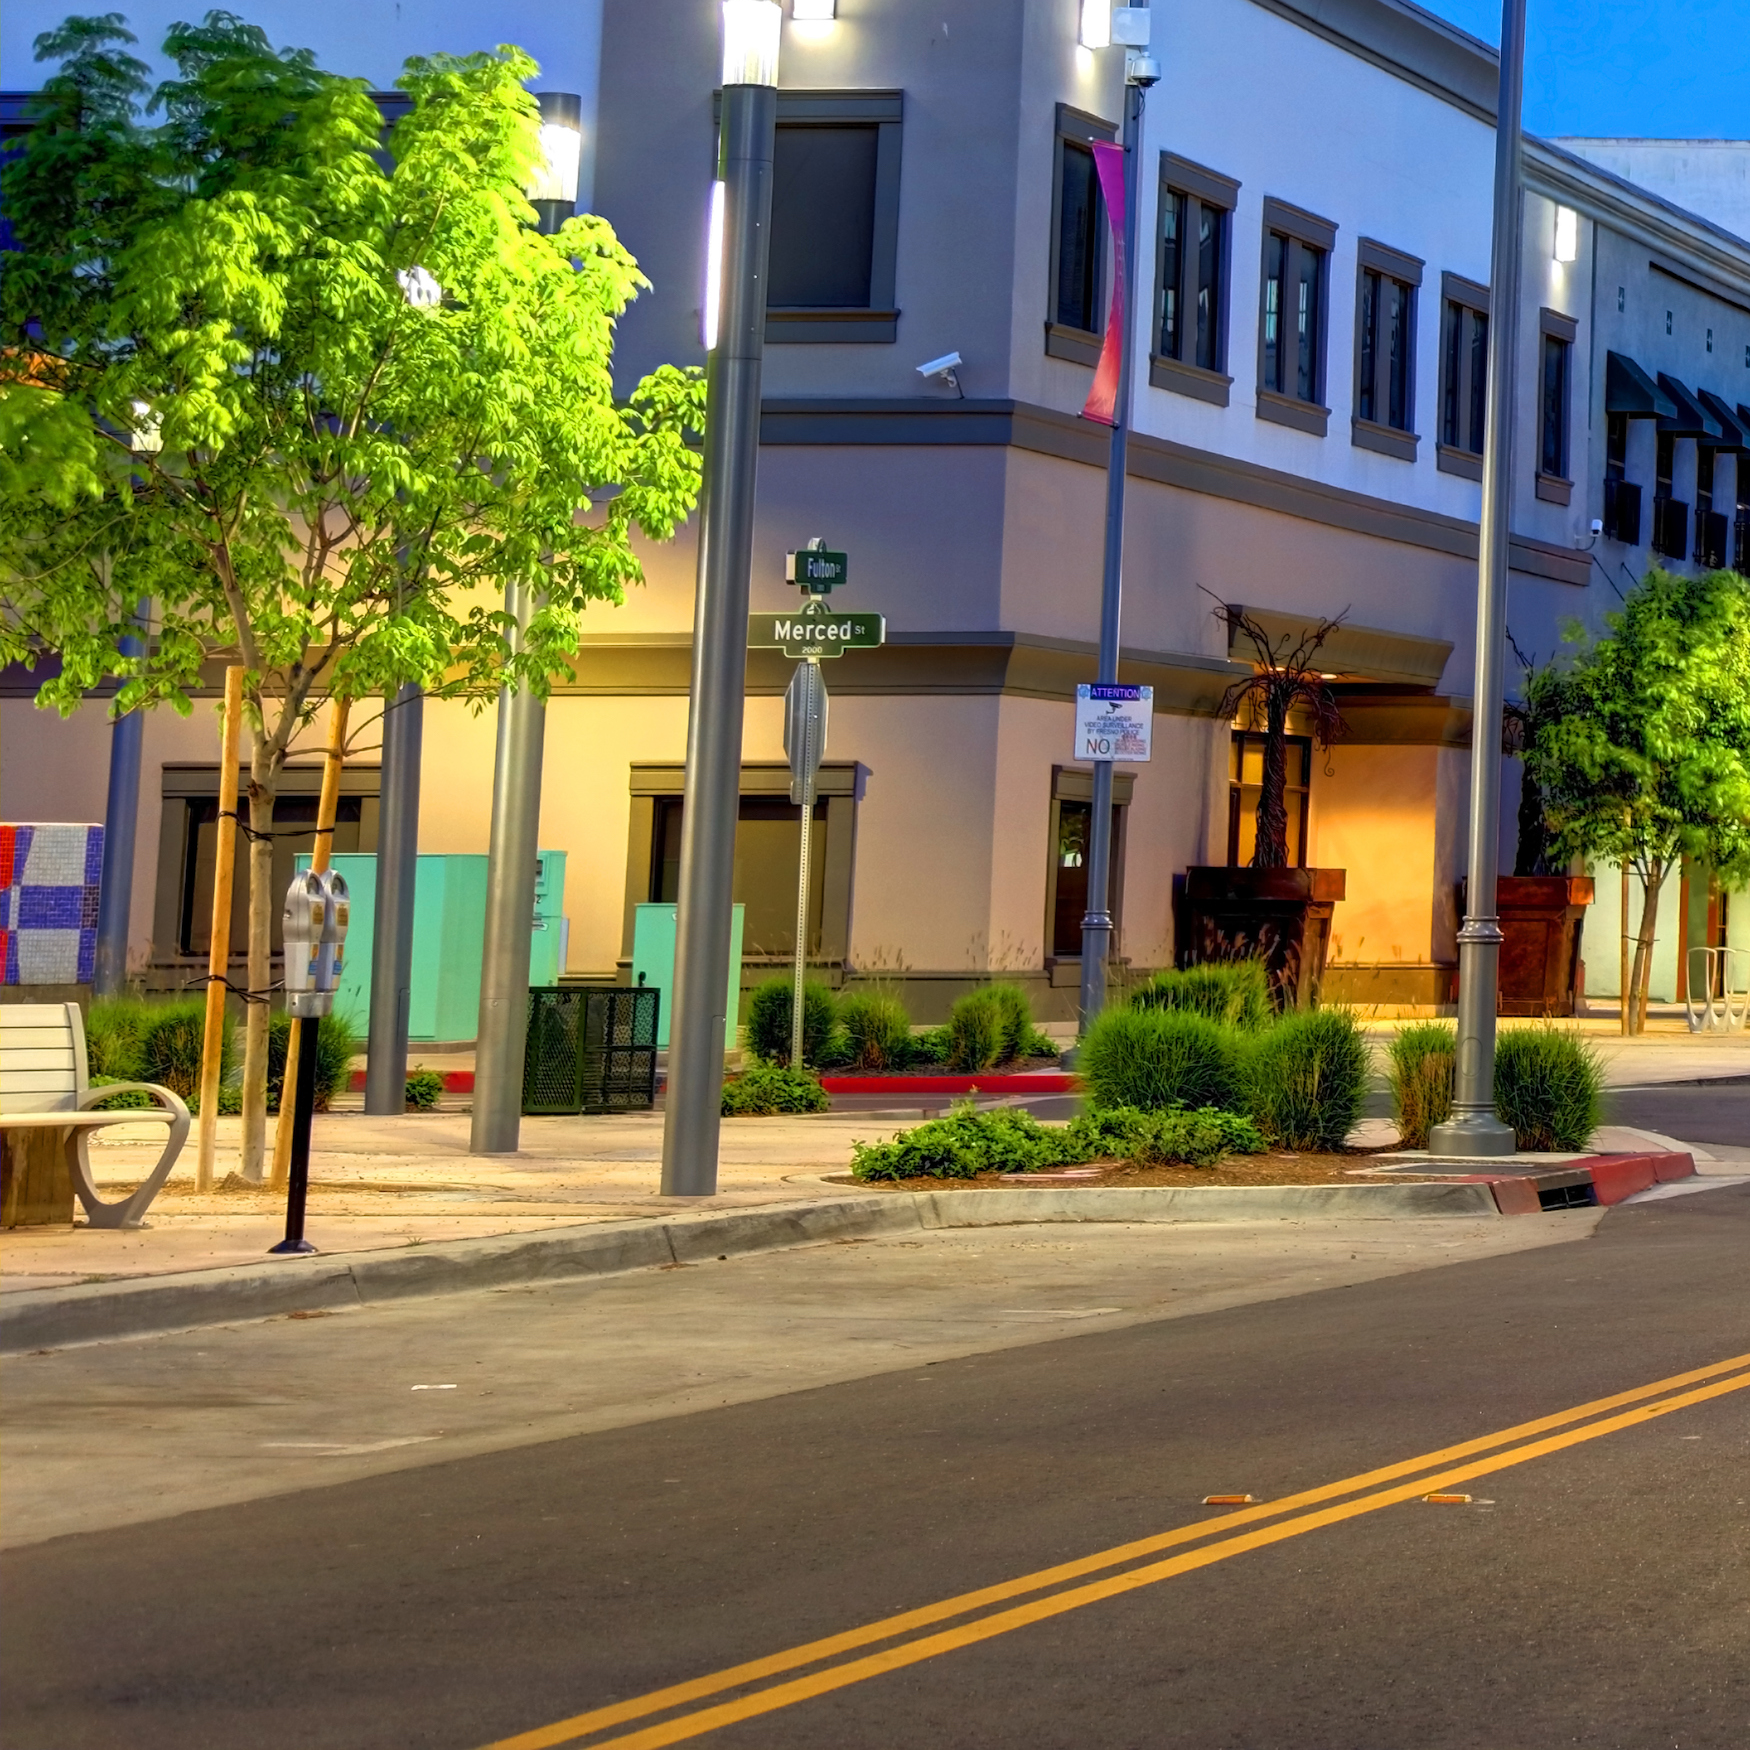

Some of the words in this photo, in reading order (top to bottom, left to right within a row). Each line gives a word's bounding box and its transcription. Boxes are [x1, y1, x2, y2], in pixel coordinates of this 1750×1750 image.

[807, 558, 836, 578] Fulton
[774, 620, 851, 641] Merced
[854, 625, 865, 635] St
[801, 646, 823, 654] 2000
[1091, 687, 1140, 699] ATTENTION
[1086, 738, 1111, 755] NO
